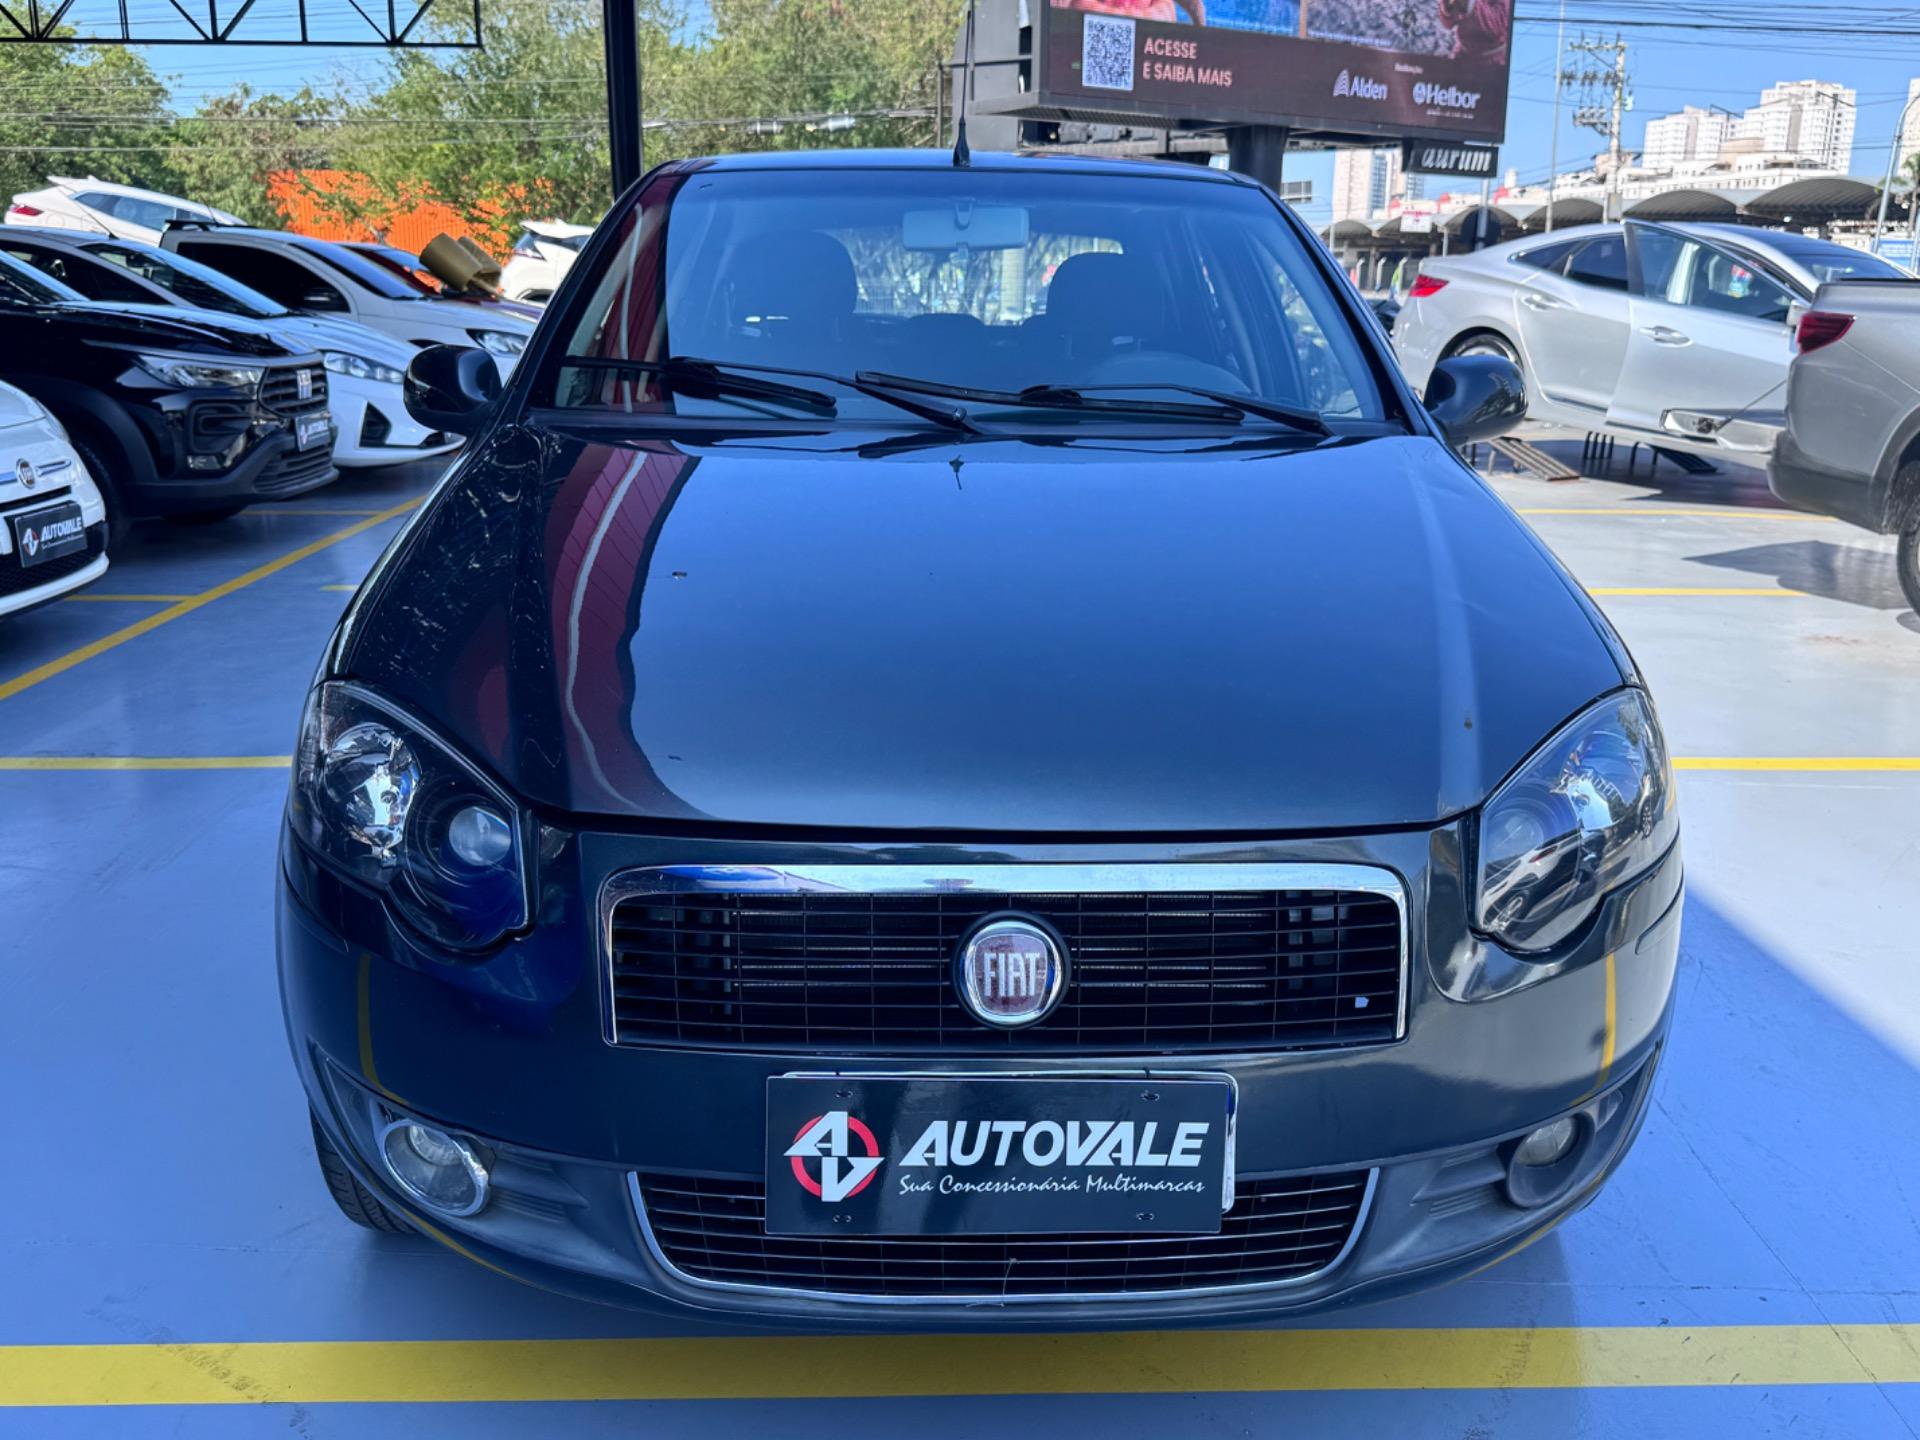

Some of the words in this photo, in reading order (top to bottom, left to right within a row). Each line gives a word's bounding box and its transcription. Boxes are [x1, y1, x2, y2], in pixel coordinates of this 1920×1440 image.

[1143, 37, 1197, 59] ACESSE
[1142, 61, 1151, 80] E
[1154, 62, 1195, 84] SAIBA
[1197, 67, 1233, 88] MAIS
[1350, 75, 1388, 100] Alden
[1427, 82, 1481, 109] Helbor
[1421, 147, 1491, 171] aurum
[41, 516, 82, 542] AUTOVALE
[983, 952, 1040, 997] FIAT
[898, 1120, 1210, 1167] AUTOVALE
[899, 1174, 933, 1196] Sua
[939, 1174, 1081, 1195] Concessionária
[1086, 1173, 1205, 1193] Multimarcas
